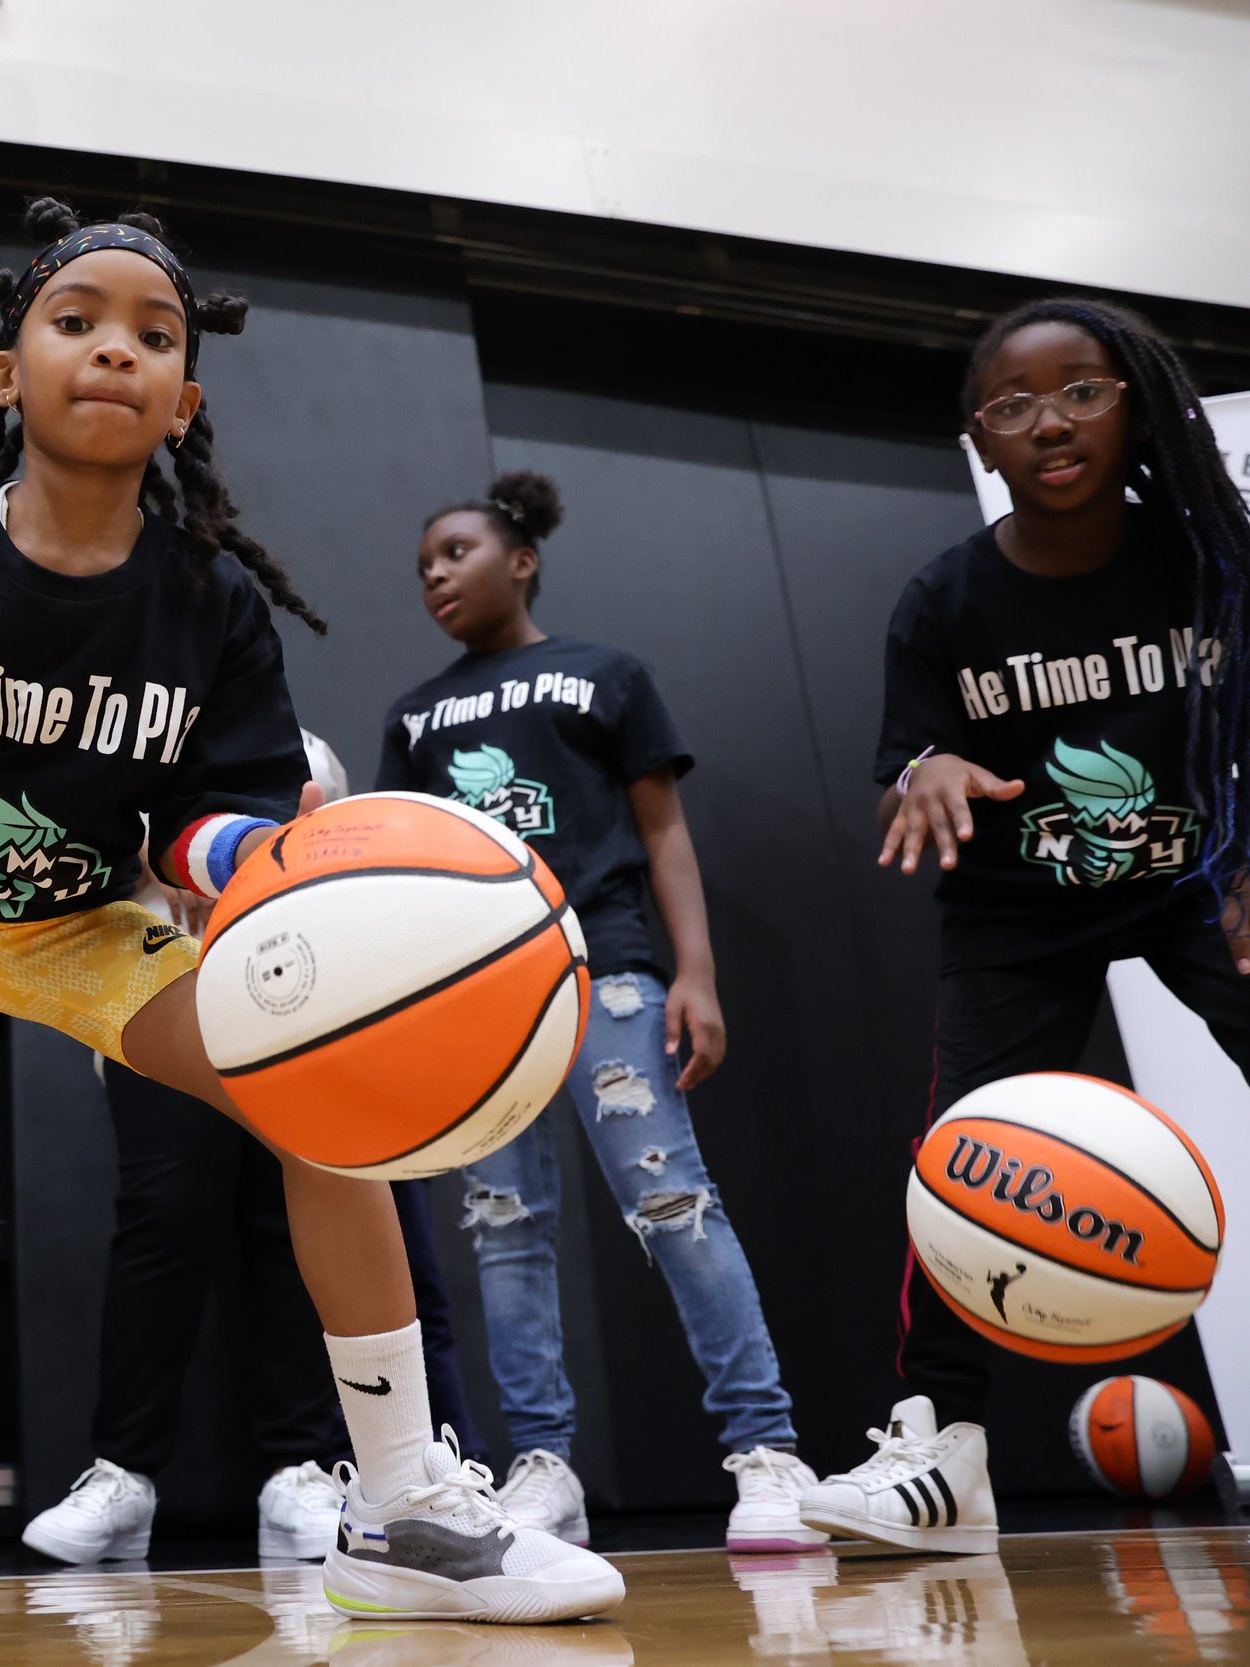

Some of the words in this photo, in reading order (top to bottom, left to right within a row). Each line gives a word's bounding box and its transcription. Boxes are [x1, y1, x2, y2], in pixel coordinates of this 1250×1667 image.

[78, 674, 128, 755] To
[431, 691, 494, 731] Time
[500, 679, 530, 713] To
[533, 672, 595, 714] Play
[957, 667, 1011, 720] He
[1006, 651, 1112, 712] Time
[1112, 635, 1166, 696] To
[145, 924, 181, 942] NIKE
[945, 1134, 1145, 1266] Wilson
